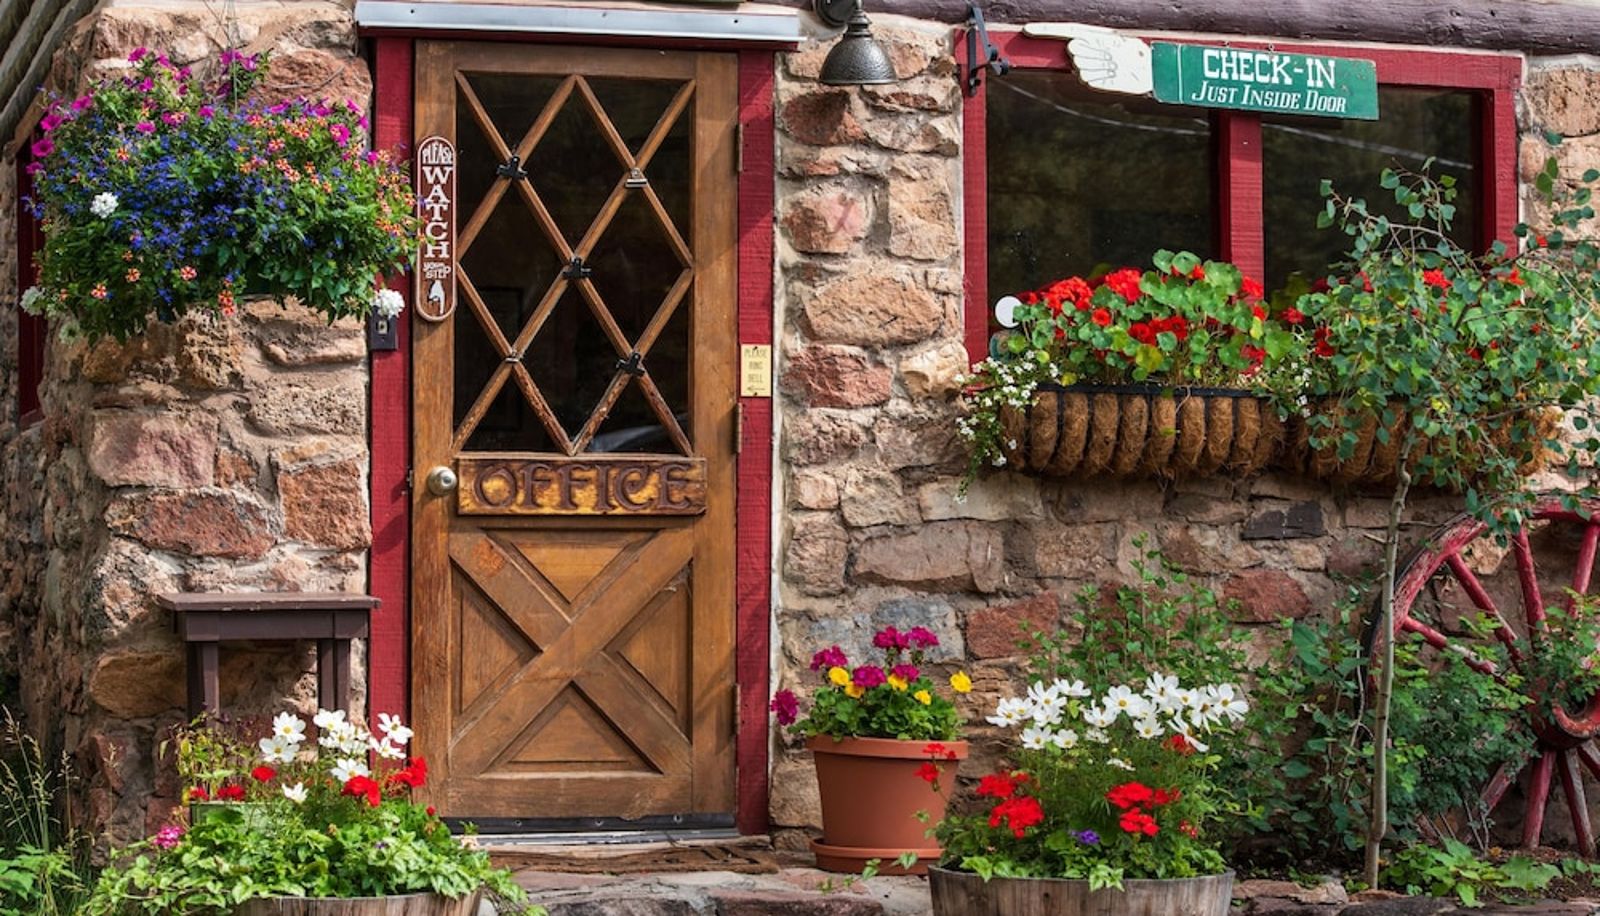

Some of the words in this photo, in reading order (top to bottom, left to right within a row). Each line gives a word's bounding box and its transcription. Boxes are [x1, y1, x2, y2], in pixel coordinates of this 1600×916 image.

[1203, 49, 1336, 89] CHECK-IN
[1191, 80, 1238, 102] JUST
[1241, 84, 1301, 109] INSIDE
[1303, 90, 1347, 113] DOOR
[422, 141, 453, 165] PLEASE
[422, 166, 453, 258] WATCH
[473, 462, 691, 512] OFFICE
